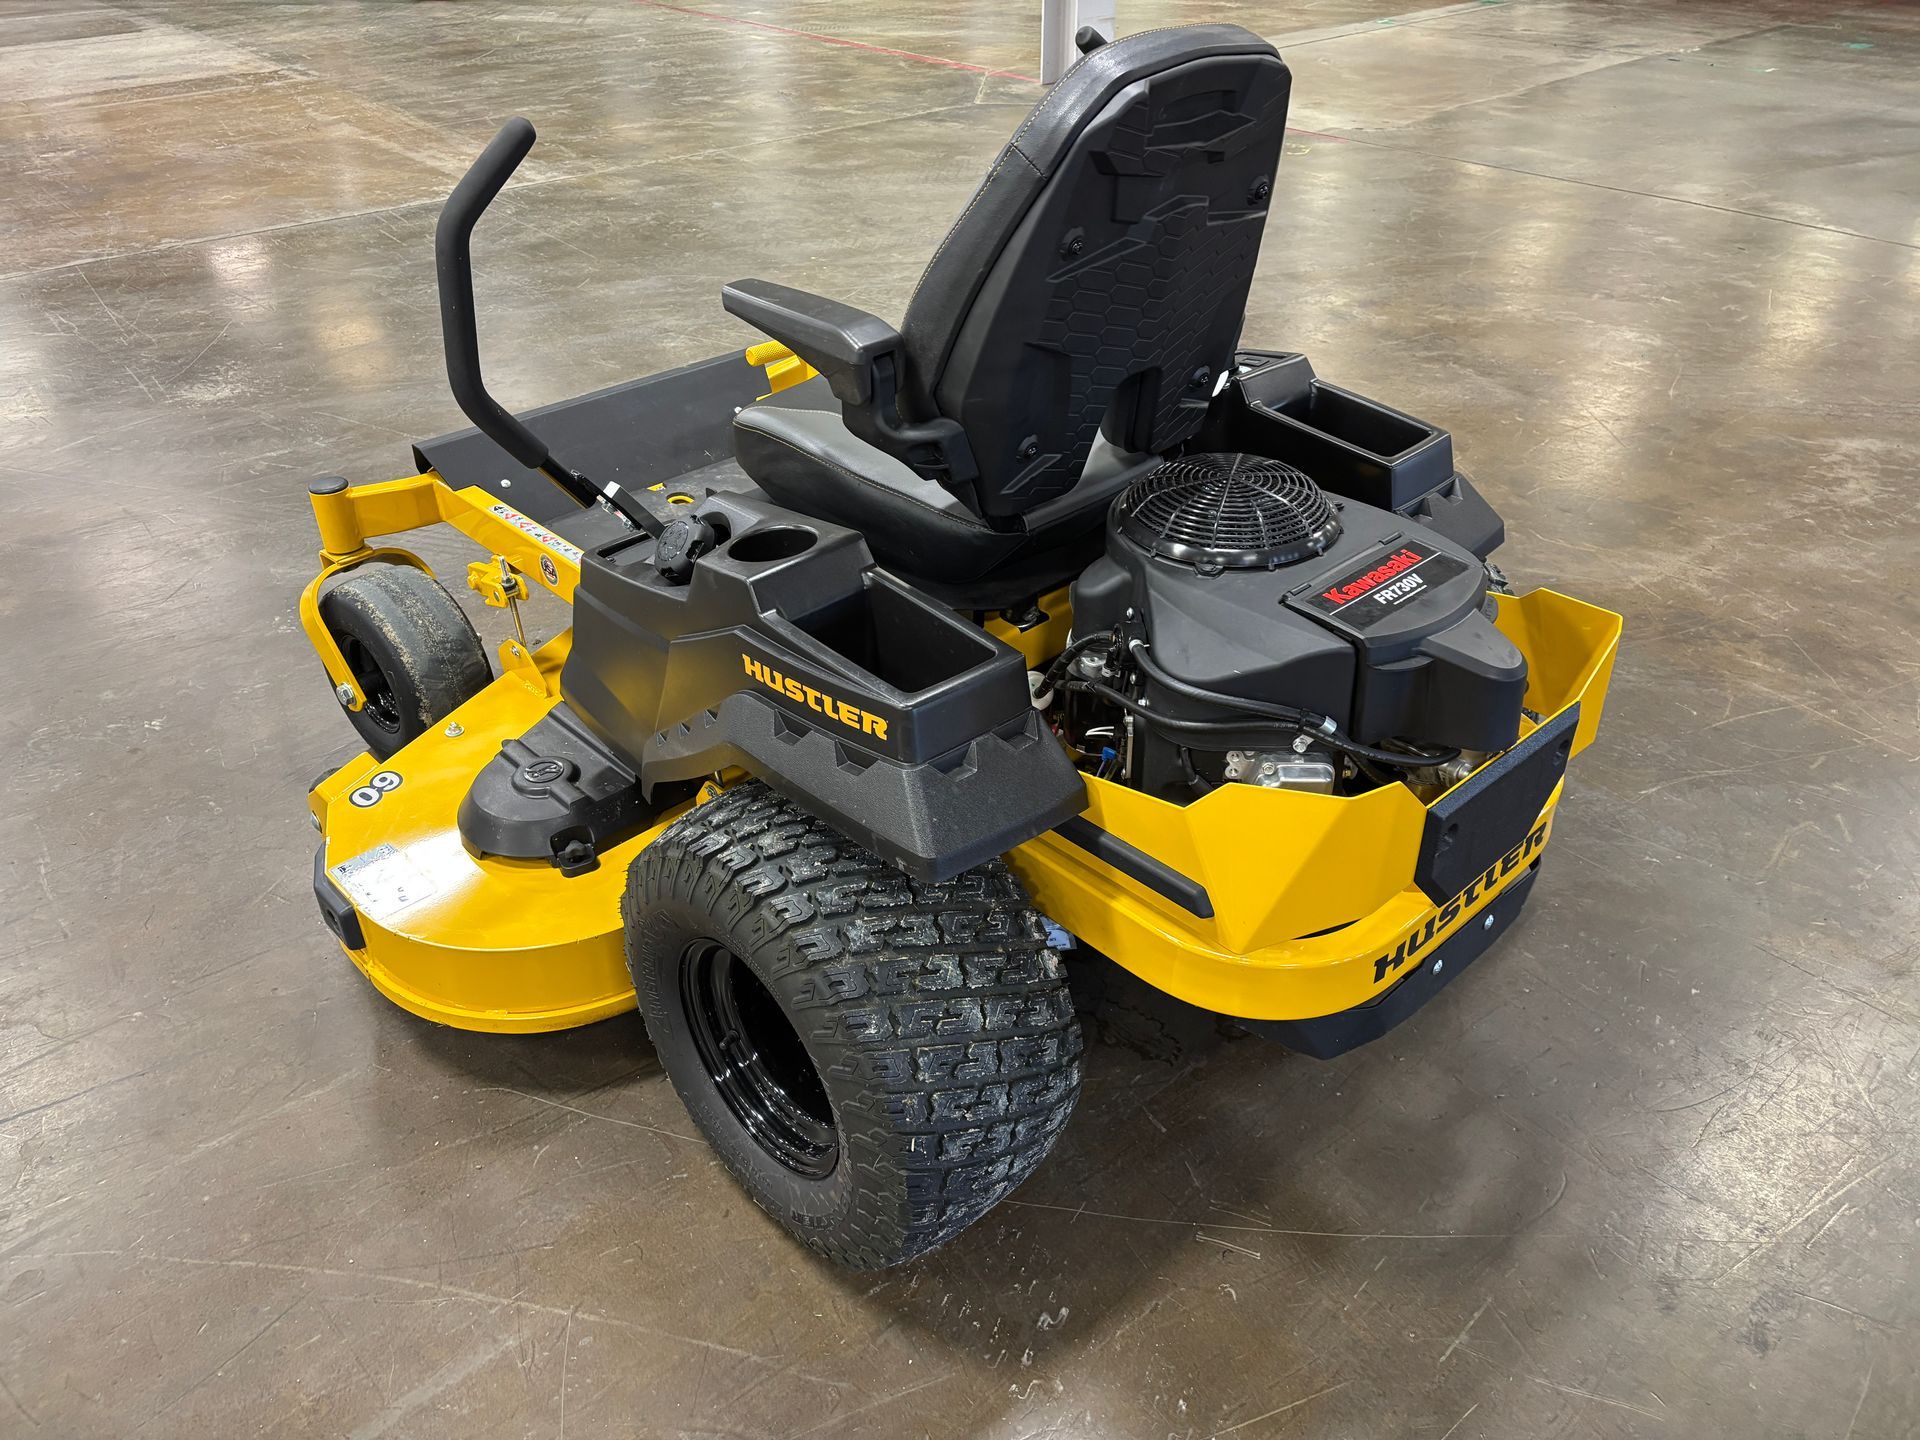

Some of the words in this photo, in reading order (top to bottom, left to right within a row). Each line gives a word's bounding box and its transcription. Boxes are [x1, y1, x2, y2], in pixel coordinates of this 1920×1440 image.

[1322, 549, 1423, 605] Kawasaki
[1372, 573, 1424, 605] FR730V
[741, 653, 888, 741] HUSTLER
[1373, 821, 1547, 984] HUSTLER
